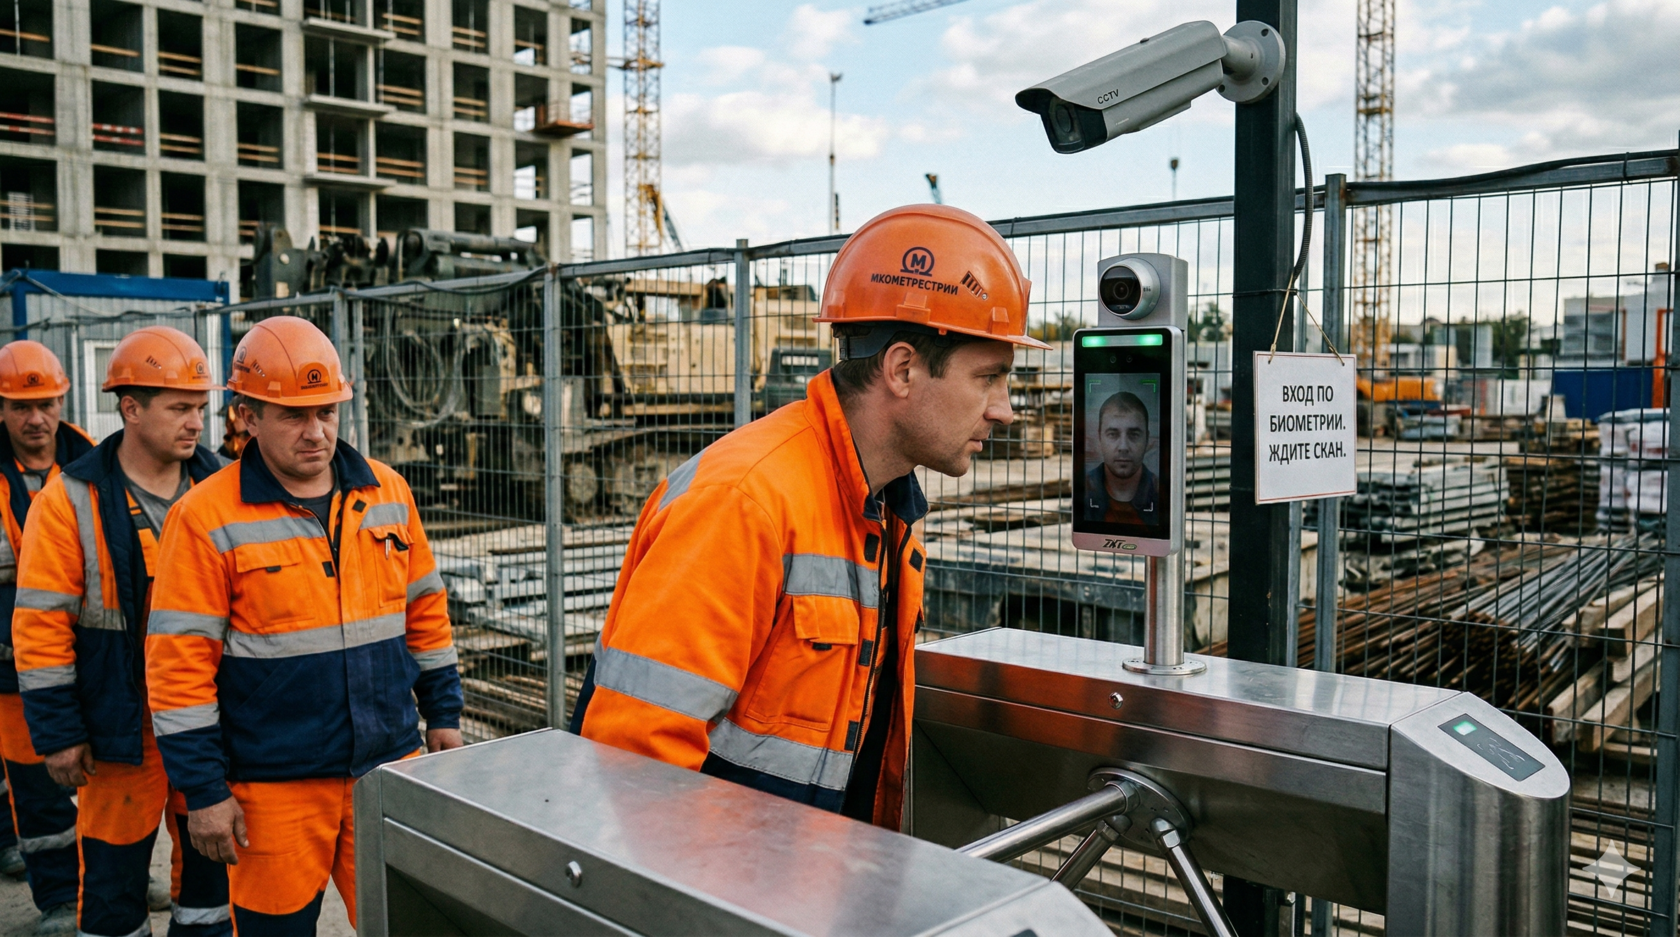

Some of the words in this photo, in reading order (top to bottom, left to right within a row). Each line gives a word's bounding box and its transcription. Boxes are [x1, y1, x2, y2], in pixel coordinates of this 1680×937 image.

[1097, 89, 1118, 104] CCTV
[871, 273, 958, 295] МКОМЕТРЕСТРИИ
[1282, 385, 1314, 406] ВХОД
[1317, 385, 1334, 402] ПО
[1270, 414, 1346, 432] БИОМЕТРИИ.
[1269, 443, 1311, 465] ЖДИТЕ
[1313, 441, 1346, 459] СКАН.
